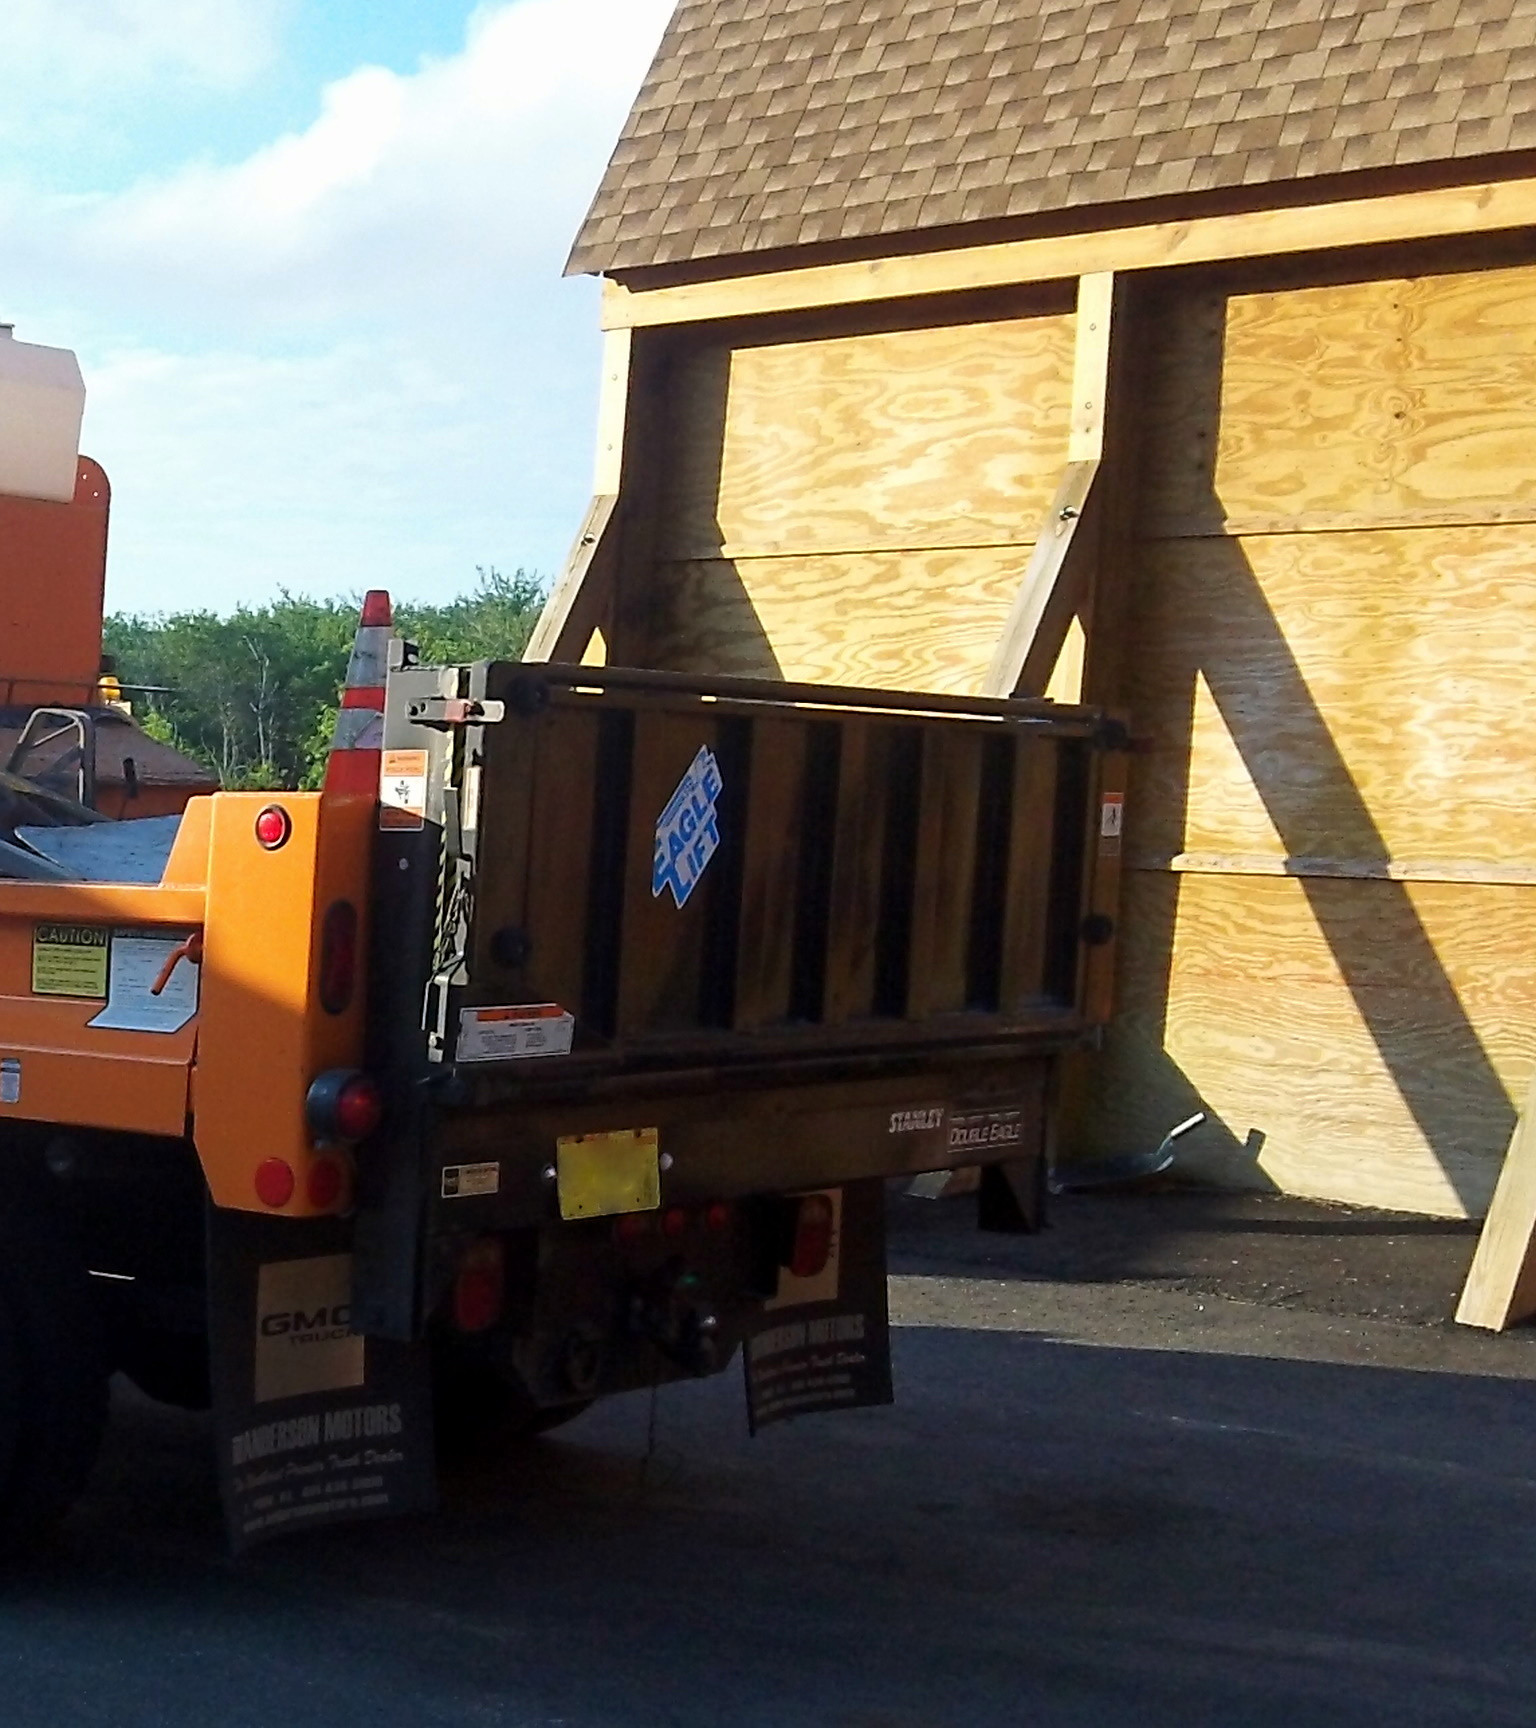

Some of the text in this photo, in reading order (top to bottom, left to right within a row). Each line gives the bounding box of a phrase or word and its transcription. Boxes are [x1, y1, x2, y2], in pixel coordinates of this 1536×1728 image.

[652, 762, 722, 894] EAGLE
[667, 812, 720, 907] LIFT
[35, 927, 106, 946] CAUTION
[888, 1107, 945, 1134] STANLEY
[261, 1304, 350, 1337] GMC
[324, 1403, 402, 1443] MOTORS
